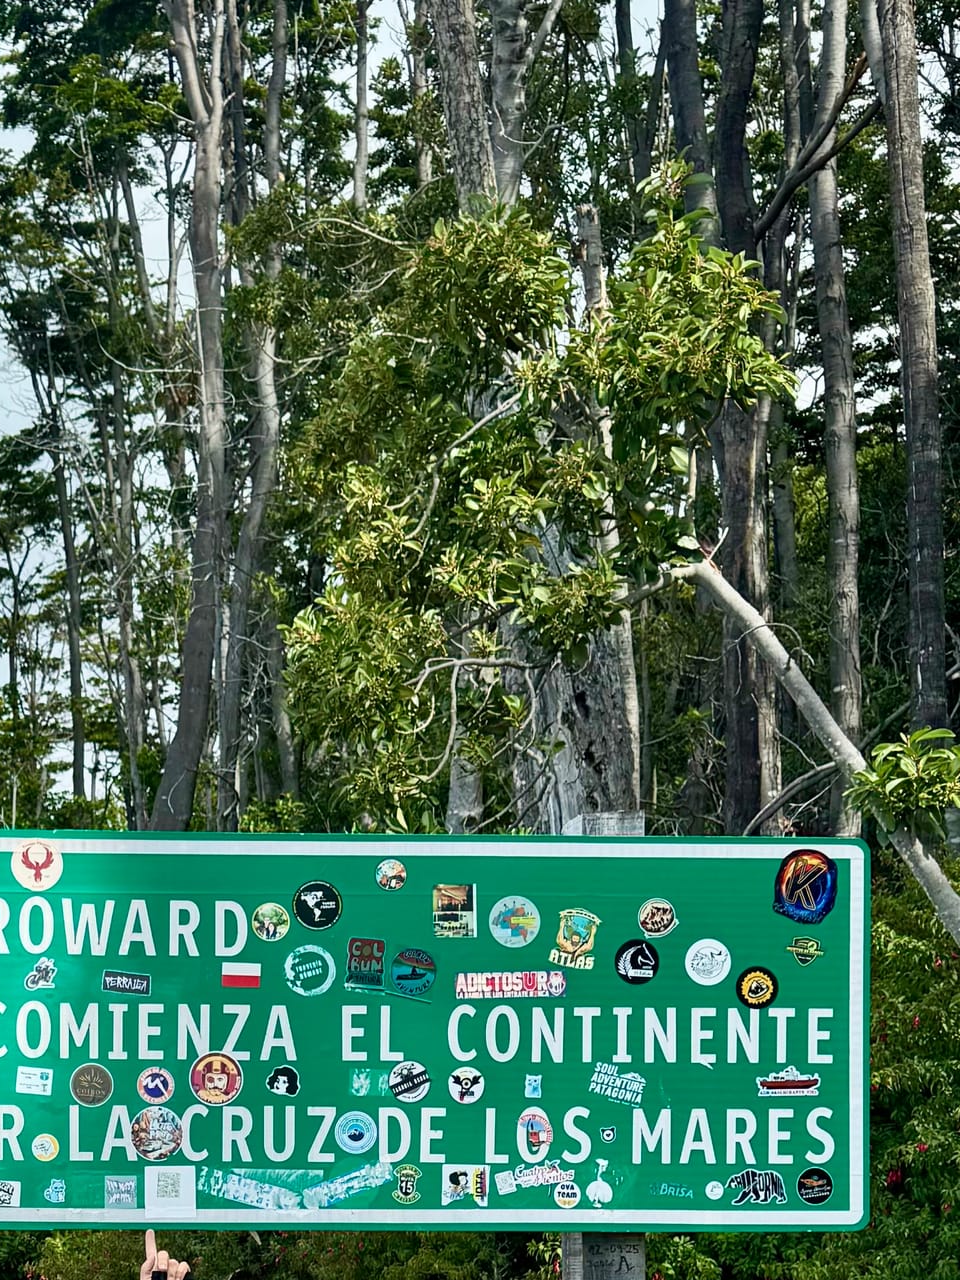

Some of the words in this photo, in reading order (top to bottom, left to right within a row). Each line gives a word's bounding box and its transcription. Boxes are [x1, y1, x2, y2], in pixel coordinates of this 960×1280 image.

[548, 948, 596, 970] ATLAS
[455, 971, 548, 992] ADICTOSUR
[341, 1004, 404, 1062] EL
[447, 1003, 835, 1064] CONTINENTE
[594, 1061, 620, 1075] SOUL
[588, 1082, 643, 1105] PATAGONIA
[590, 1072, 647, 1094] ADVENTURE
[68, 1104, 138, 1162] LA
[179, 1103, 337, 1163] CRUZ
[378, 1106, 447, 1164] DE
[485, 1106, 592, 1165] LOS
[631, 1106, 836, 1165] MARES
[400, 1181, 414, 1193] 15
[660, 1182, 693, 1199] BRISA
[727, 1169, 787, 1202] CALIFORNIA
